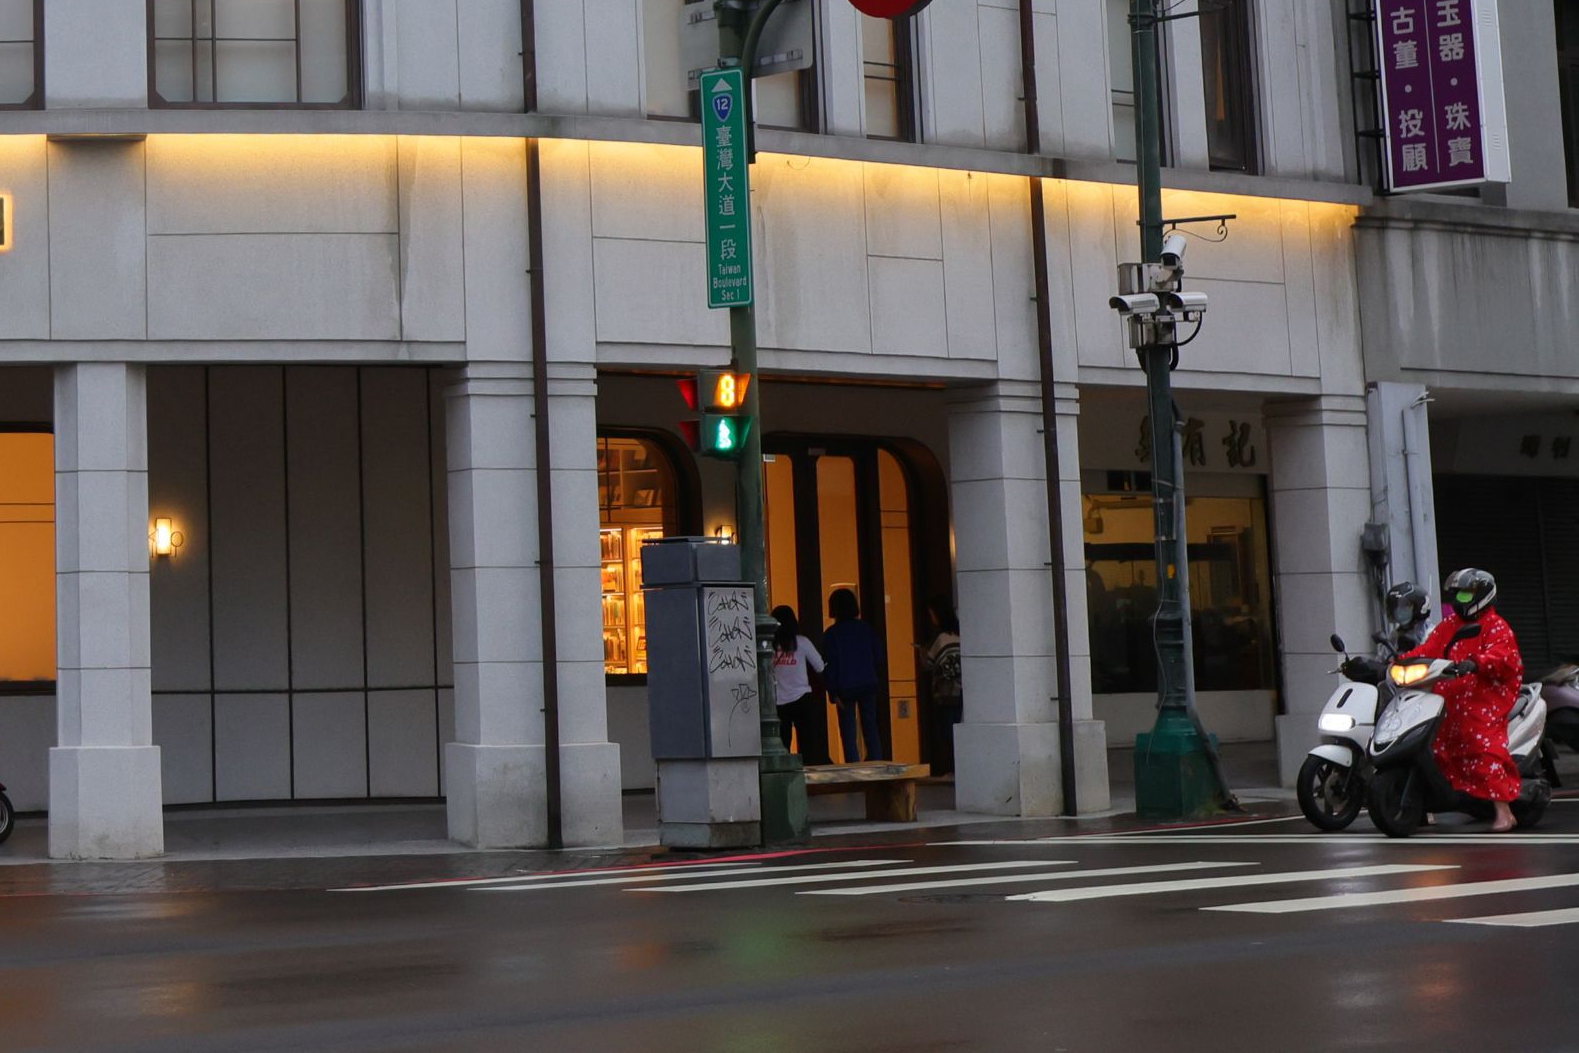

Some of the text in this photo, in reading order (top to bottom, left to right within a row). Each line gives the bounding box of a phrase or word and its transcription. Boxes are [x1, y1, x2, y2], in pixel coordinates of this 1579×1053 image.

[716, 98, 729, 110] 12
[715, 125, 737, 260] 臺灣大道一段
[718, 263, 741, 275] Taiwan
[713, 275, 747, 289] Boulevard
